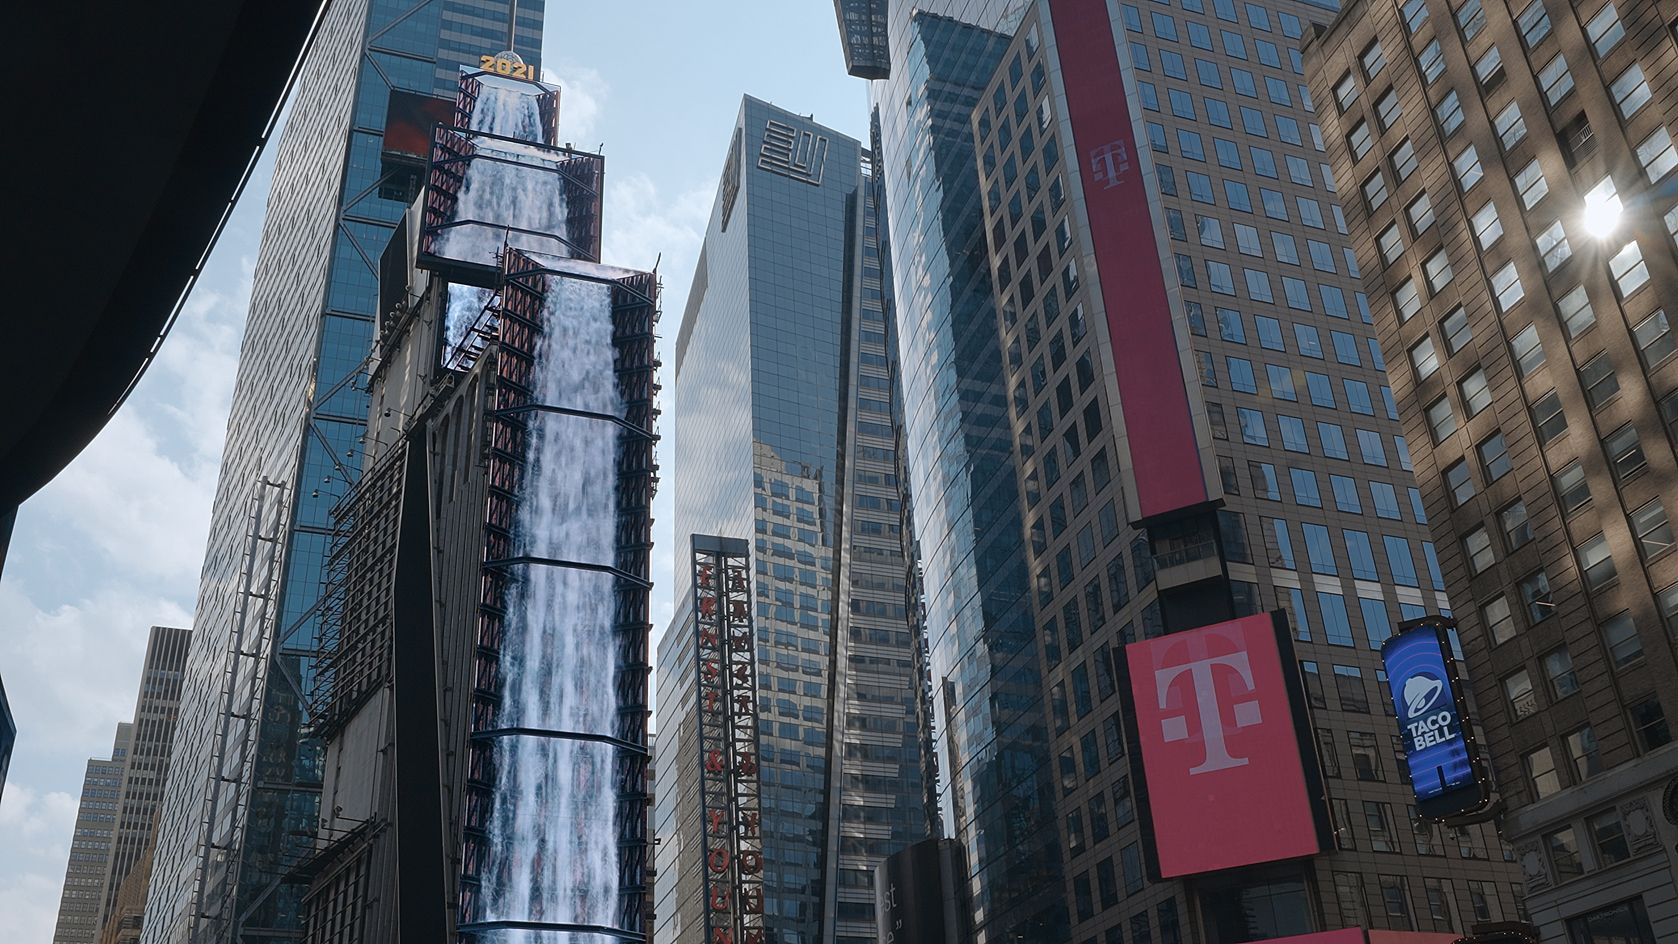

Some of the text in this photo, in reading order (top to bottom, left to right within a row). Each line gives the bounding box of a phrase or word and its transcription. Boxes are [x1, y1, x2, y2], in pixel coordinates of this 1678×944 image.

[480, 55, 534, 81] 2021
[701, 565, 719, 715] ERNST
[1155, 651, 1260, 775] T
[1407, 711, 1451, 738] TACO
[1414, 726, 1456, 751] BELL
[706, 750, 724, 774] &
